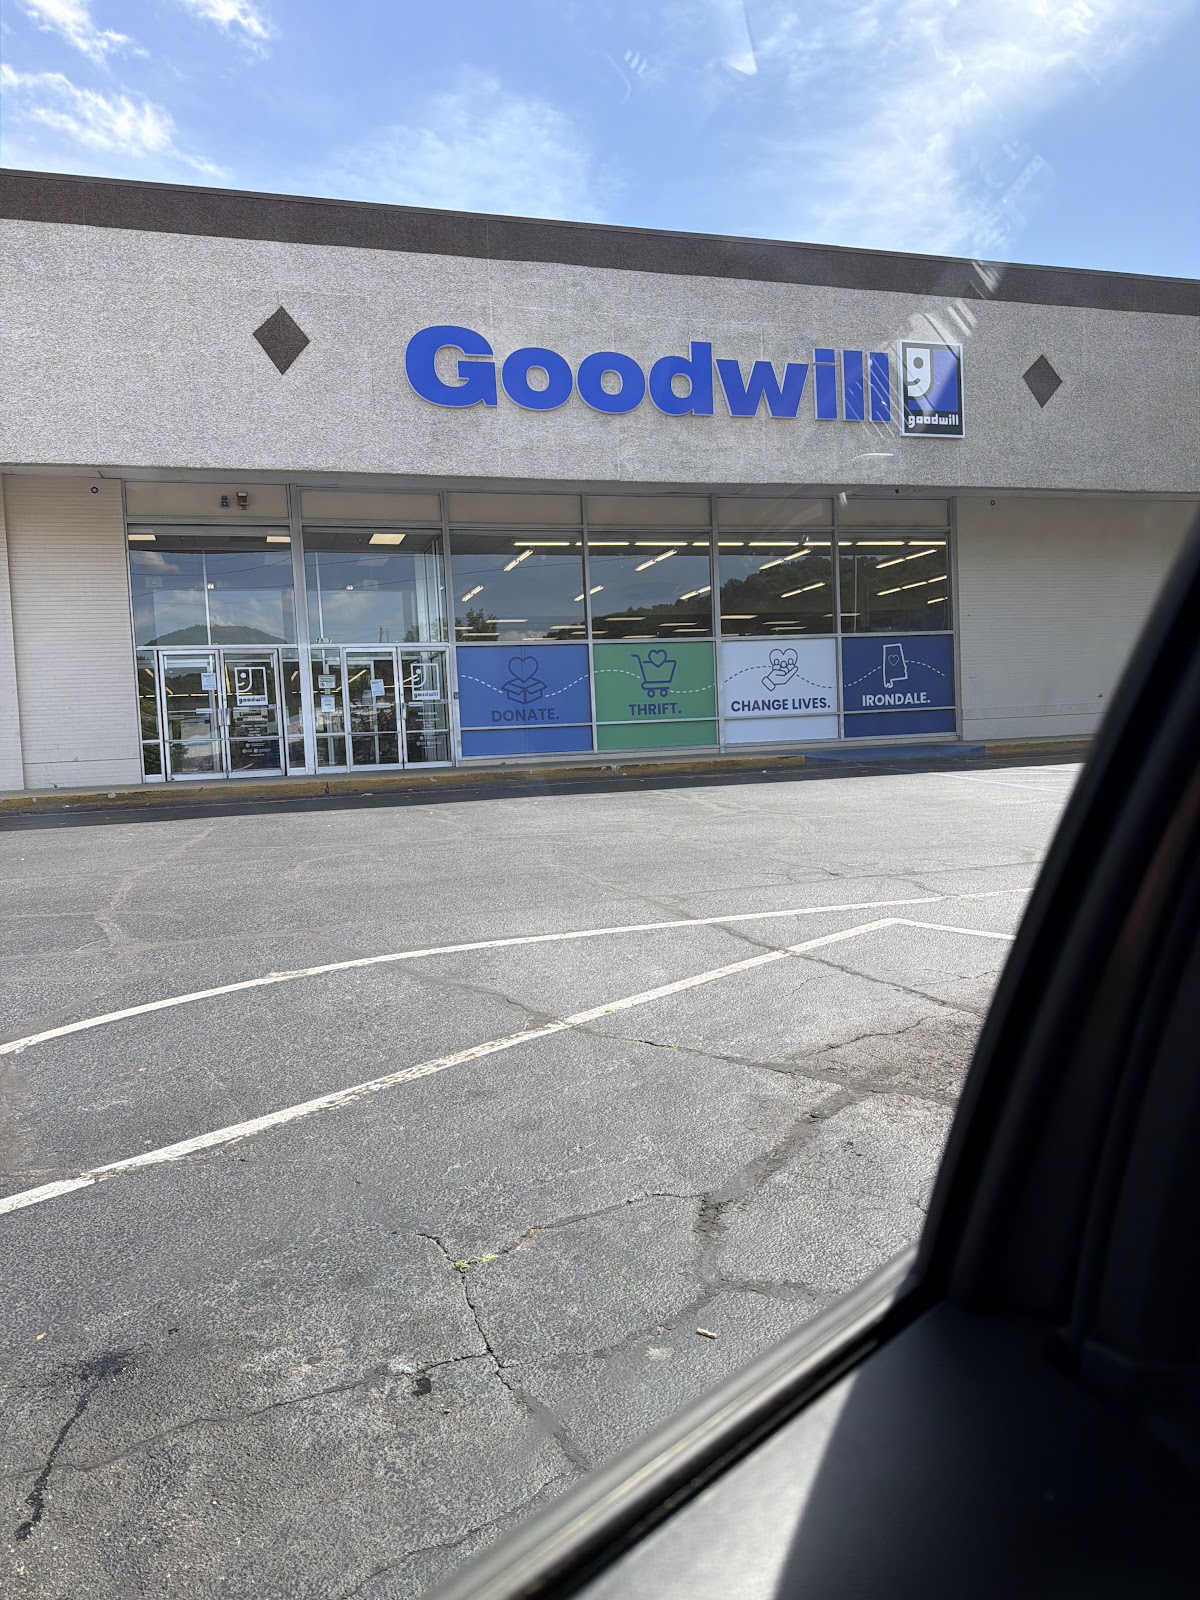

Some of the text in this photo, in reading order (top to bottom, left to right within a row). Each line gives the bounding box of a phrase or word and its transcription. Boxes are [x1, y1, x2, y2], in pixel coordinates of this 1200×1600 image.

[405, 325, 891, 421] Goodwill
[908, 413, 959, 429] goodwill
[238, 696, 266, 705] goodwill
[731, 697, 831, 712] CHANGE LIVES.
[862, 692, 931, 707] IRONDALE.
[491, 708, 560, 723] DONATE.
[628, 702, 682, 716] THRIFT.
